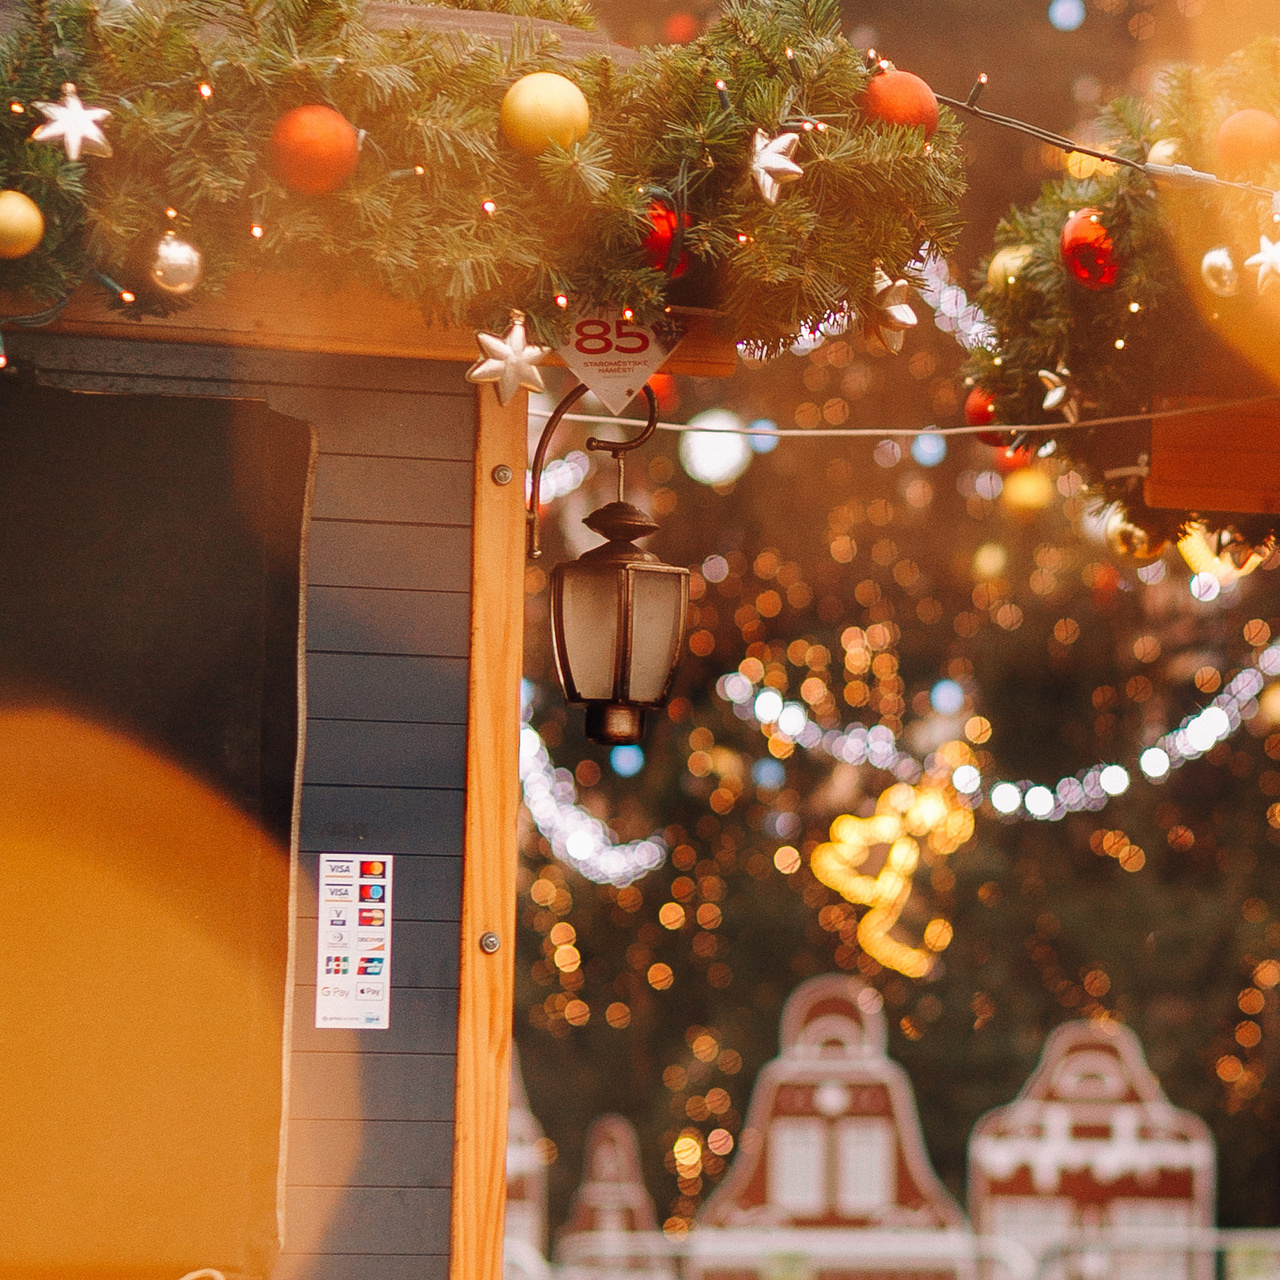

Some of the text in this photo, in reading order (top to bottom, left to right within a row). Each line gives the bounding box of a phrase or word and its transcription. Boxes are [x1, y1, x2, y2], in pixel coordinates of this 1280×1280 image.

[575, 319, 650, 355] 85
[329, 865, 350, 873] VISA
[329, 888, 349, 896] VISA
